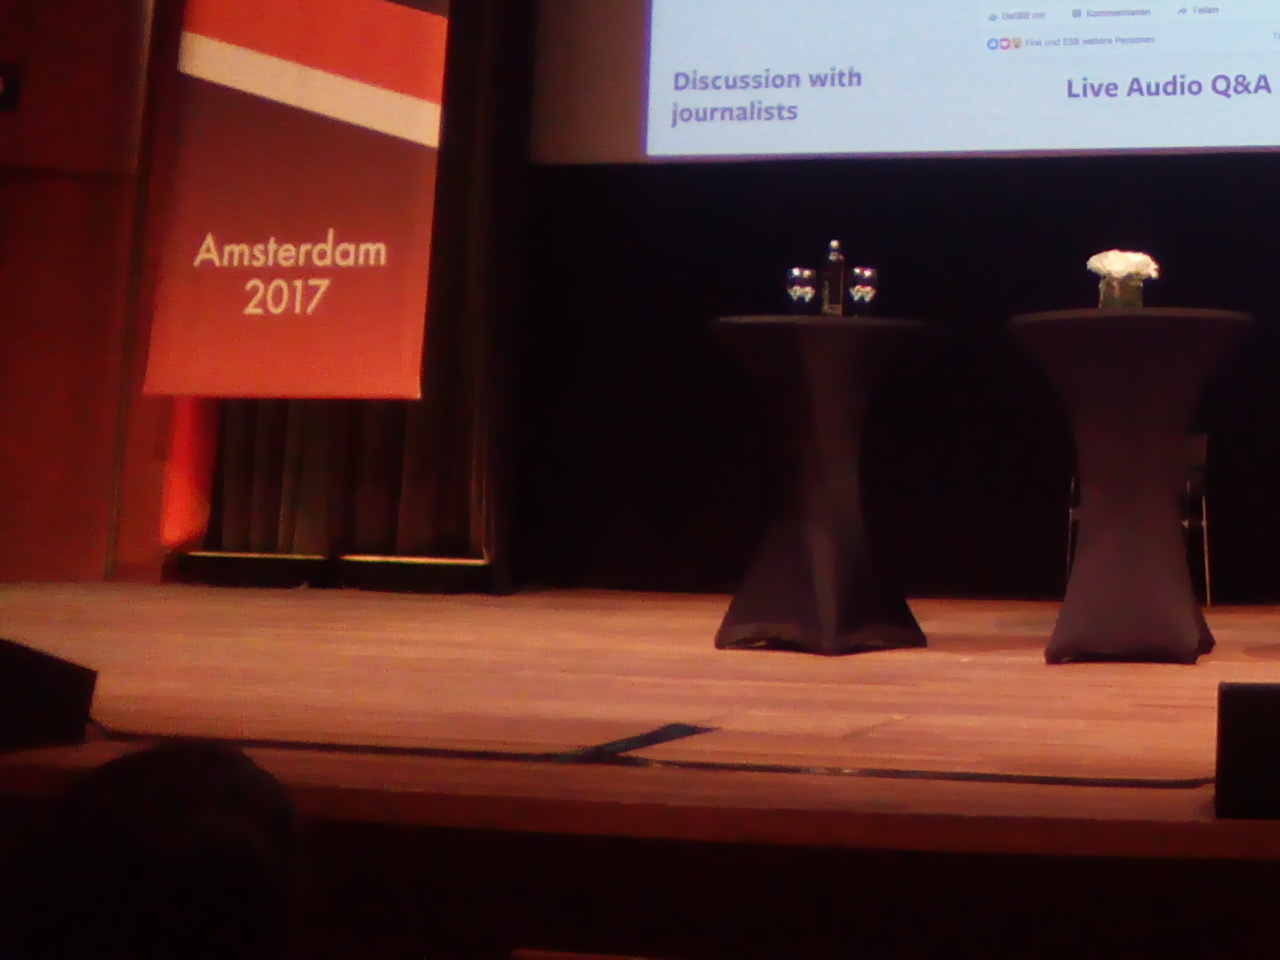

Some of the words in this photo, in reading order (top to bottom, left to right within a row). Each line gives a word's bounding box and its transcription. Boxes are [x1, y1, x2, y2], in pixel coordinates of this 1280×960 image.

[1045, 38, 1060, 46] und
[673, 69, 801, 91] Discussion
[809, 66, 862, 88] with
[1067, 76, 1119, 98] Live
[1126, 74, 1202, 97] Audio
[1211, 73, 1272, 99] Q&A
[671, 100, 798, 128] journalists
[193, 228, 387, 267] Amsterdam
[242, 278, 330, 315] 2017
